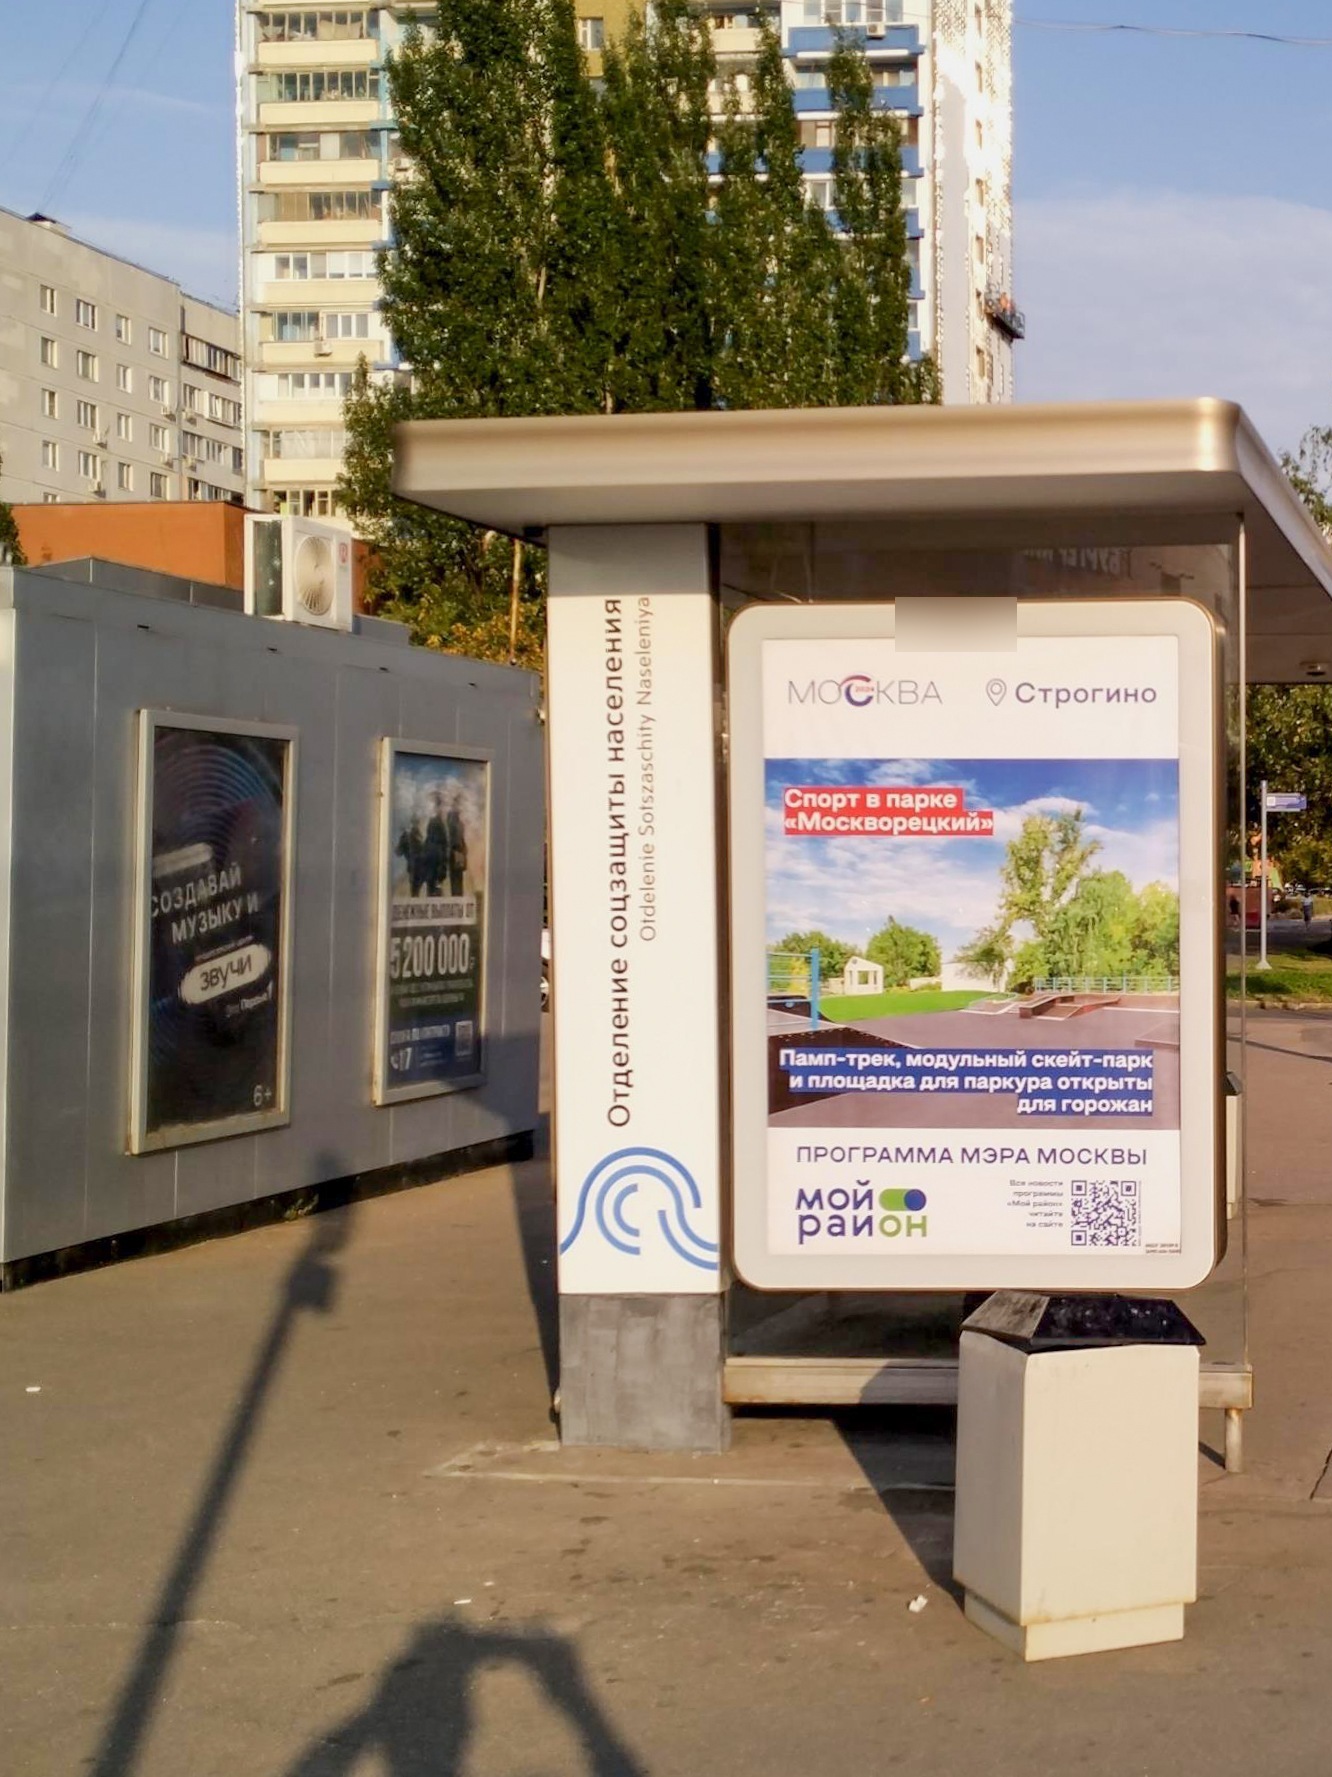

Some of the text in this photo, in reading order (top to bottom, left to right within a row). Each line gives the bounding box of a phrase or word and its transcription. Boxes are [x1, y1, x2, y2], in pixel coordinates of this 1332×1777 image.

[788, 674, 943, 707] МОСКВА
[1015, 682, 1157, 709] Строгино
[635, 596, 658, 942] Otdelenie Sotszaschity Naseleniya
[784, 788, 957, 812] Спорт в парке
[784, 811, 994, 836] «Москворецкий»
[603, 598, 634, 1127] Отделение соцзащиты населения
[171, 897, 242, 945] МУЗЫКУ
[402, 934, 435, 978] 200
[437, 932, 469, 976] 000
[779, 1049, 1153, 1072] Памп-трек, модульный скейт-парк
[253, 1084, 272, 1106] 6+
[789, 1074, 1153, 1093] и площадка для паркура открыты
[1017, 1098, 1153, 1115] для горожан
[796, 1146, 1147, 1165] ПРОГРАММА МЭРА МОСКВЫ
[795, 1179, 874, 1211] мой
